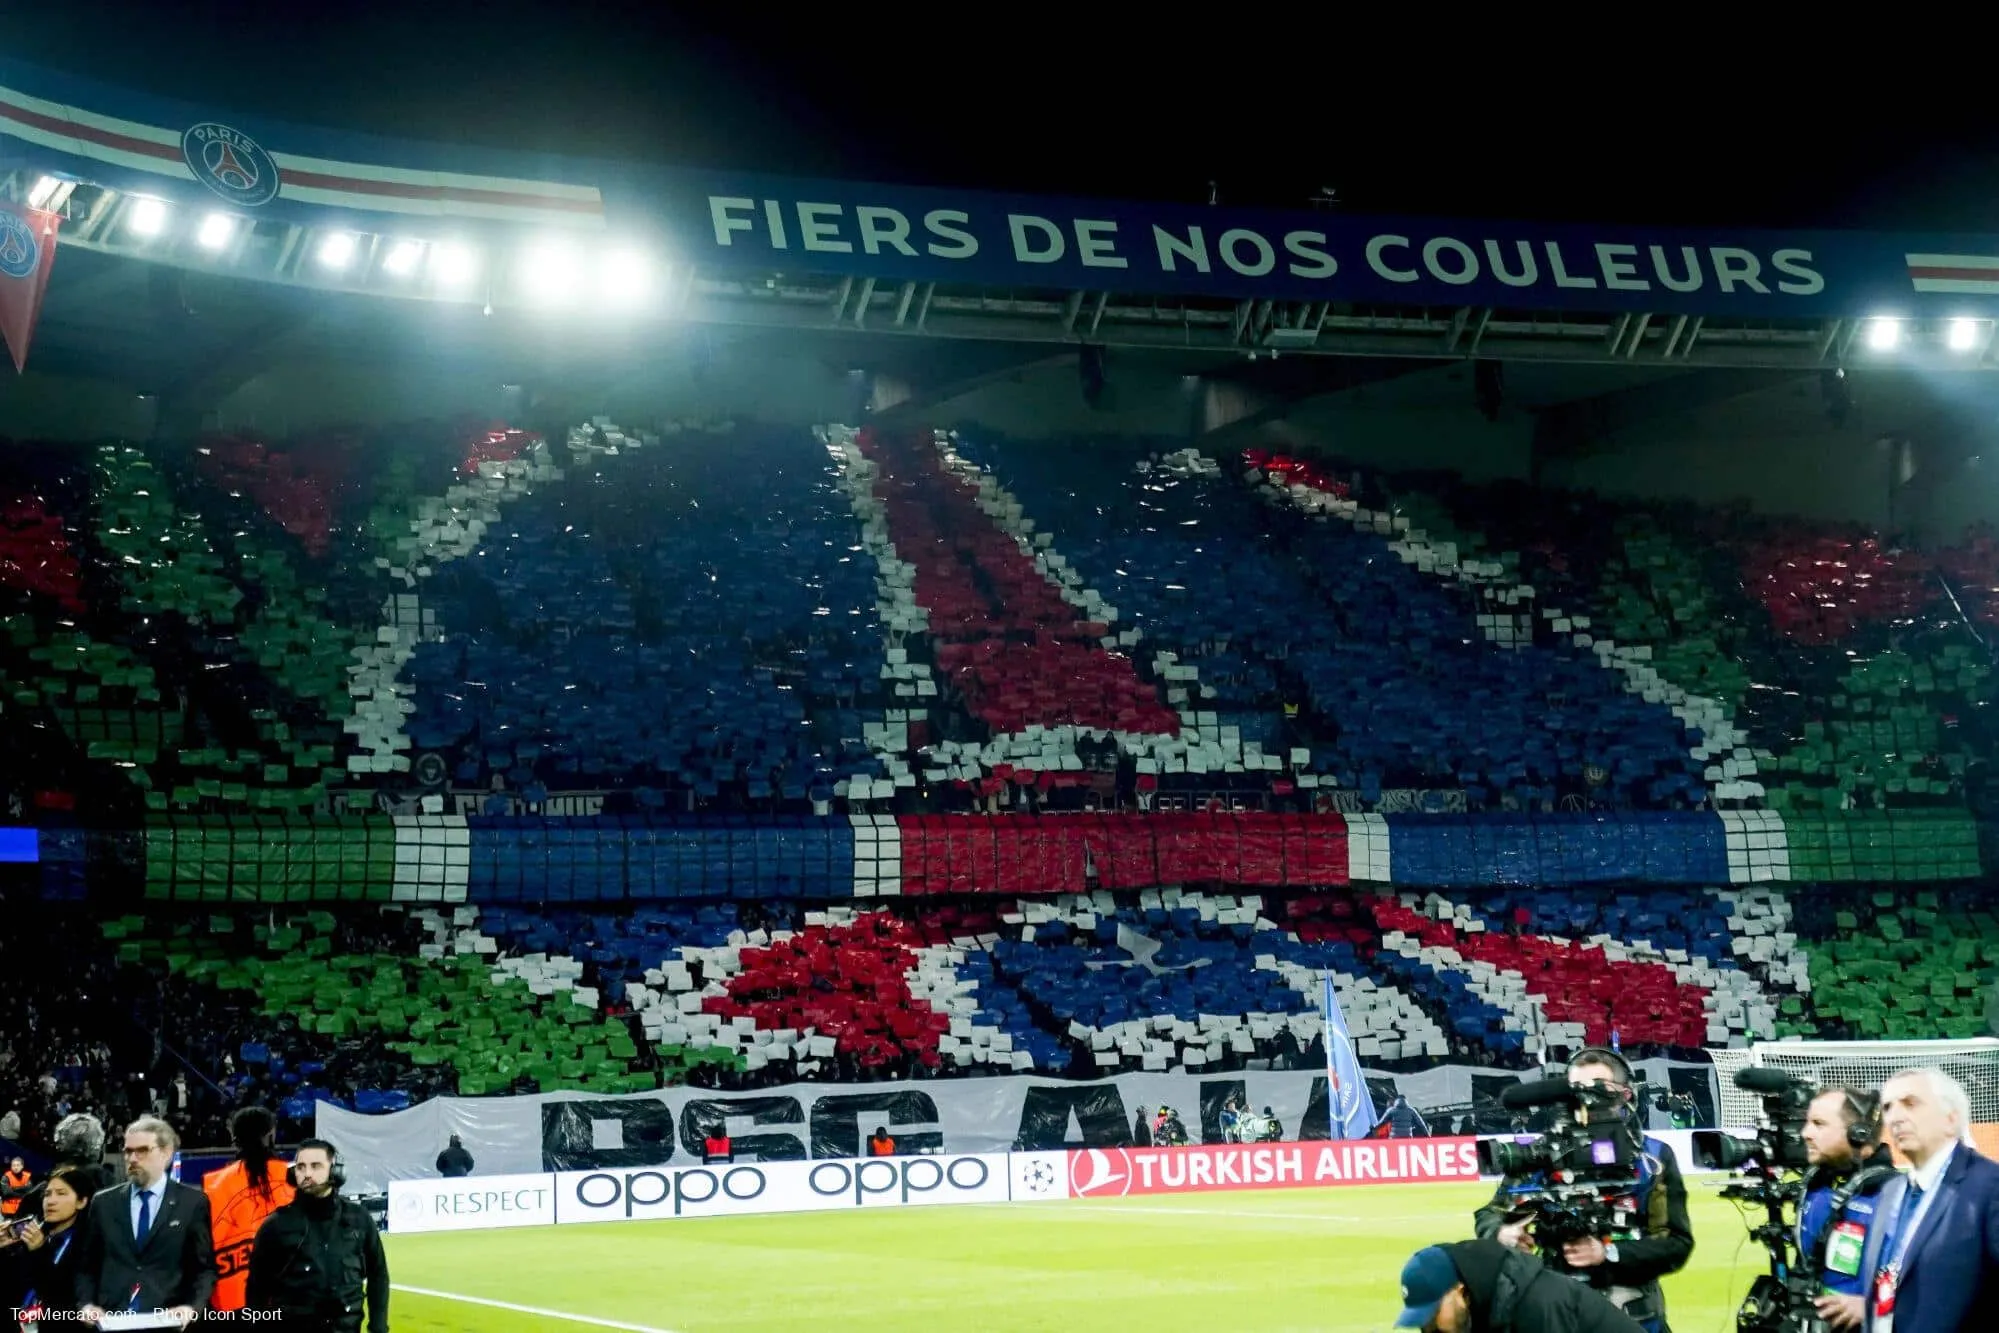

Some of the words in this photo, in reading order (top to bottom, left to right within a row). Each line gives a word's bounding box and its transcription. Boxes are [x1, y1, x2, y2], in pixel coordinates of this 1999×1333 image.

[194, 126, 254, 153] PARIS
[708, 196, 979, 259] FIERS
[1008, 214, 1128, 268] DE
[1152, 223, 1338, 279] NOS
[1365, 234, 1825, 295] COULEURS
[542, 1090, 944, 1172] PSG
[576, 1166, 767, 1217] oppo
[809, 1157, 989, 1206] oppo
[1135, 1148, 1303, 1187] TURKISH
[1314, 1143, 1479, 1181] AIRLINES
[435, 1189, 548, 1216] RESPECT
[215, 1243, 253, 1275] STE
